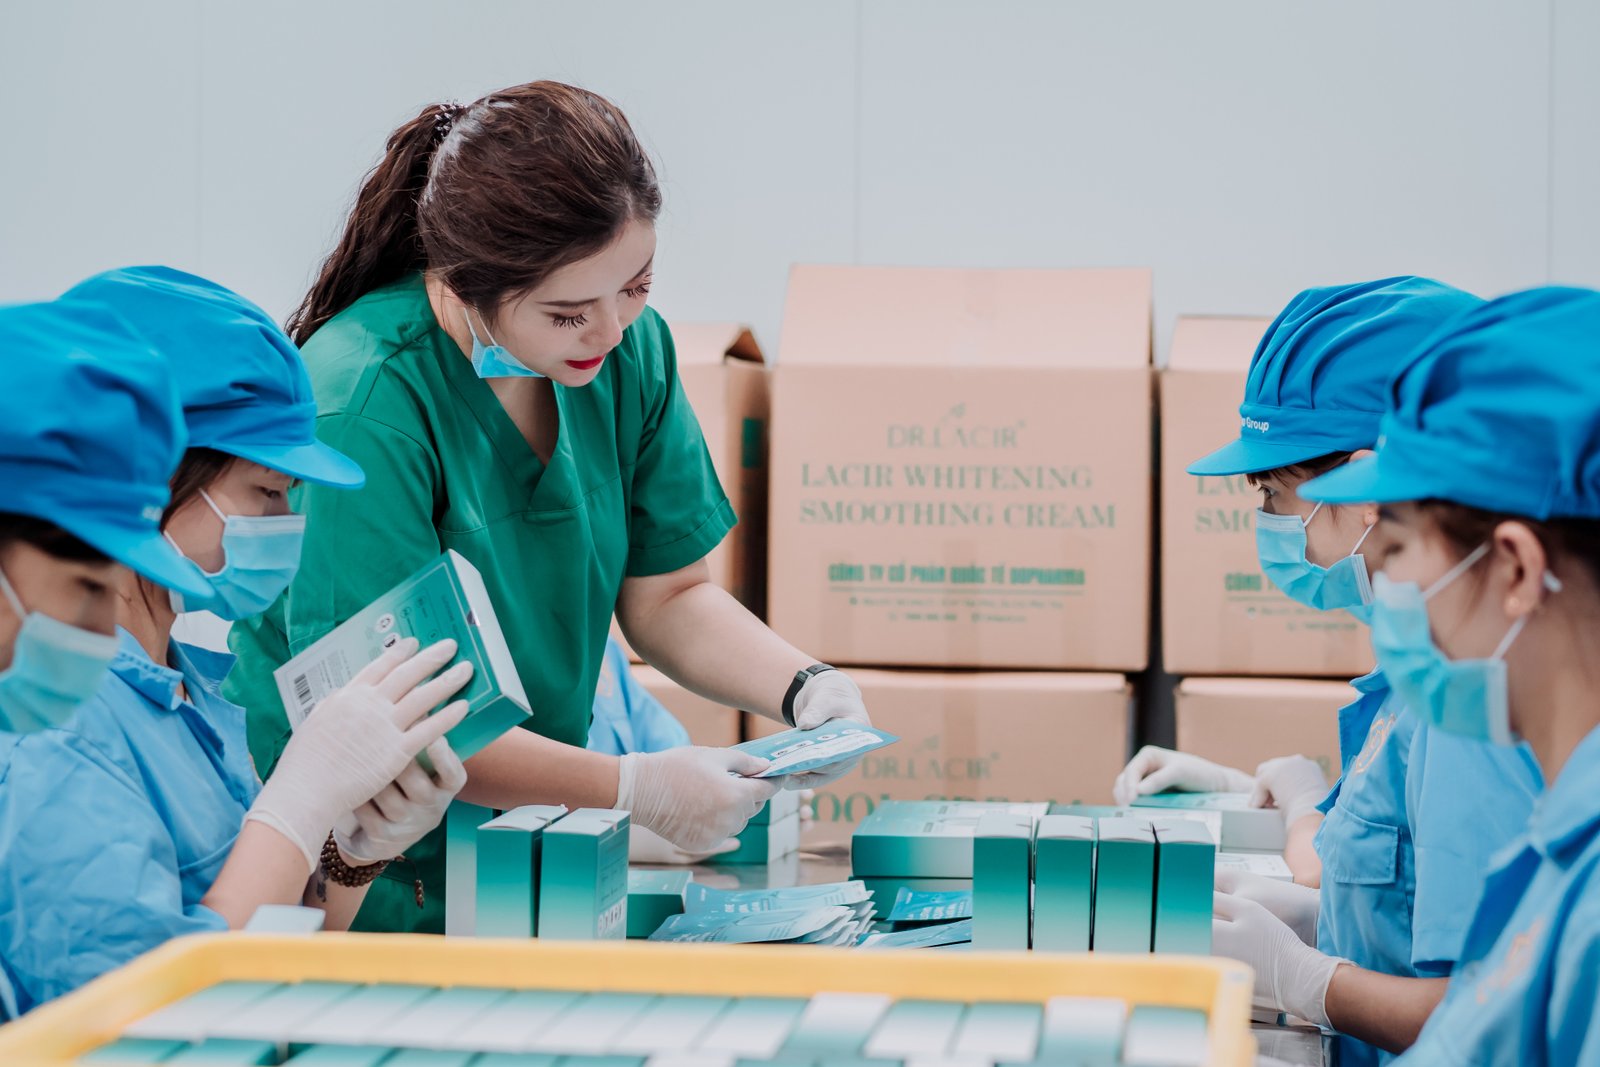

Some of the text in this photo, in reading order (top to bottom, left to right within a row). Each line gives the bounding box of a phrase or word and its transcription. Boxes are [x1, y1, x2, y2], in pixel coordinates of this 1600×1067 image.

[1246, 417, 1269, 433] Group
[801, 464, 1093, 490] LACIR WHITENING
[801, 500, 1116, 528] SMOOTHING CREAM
